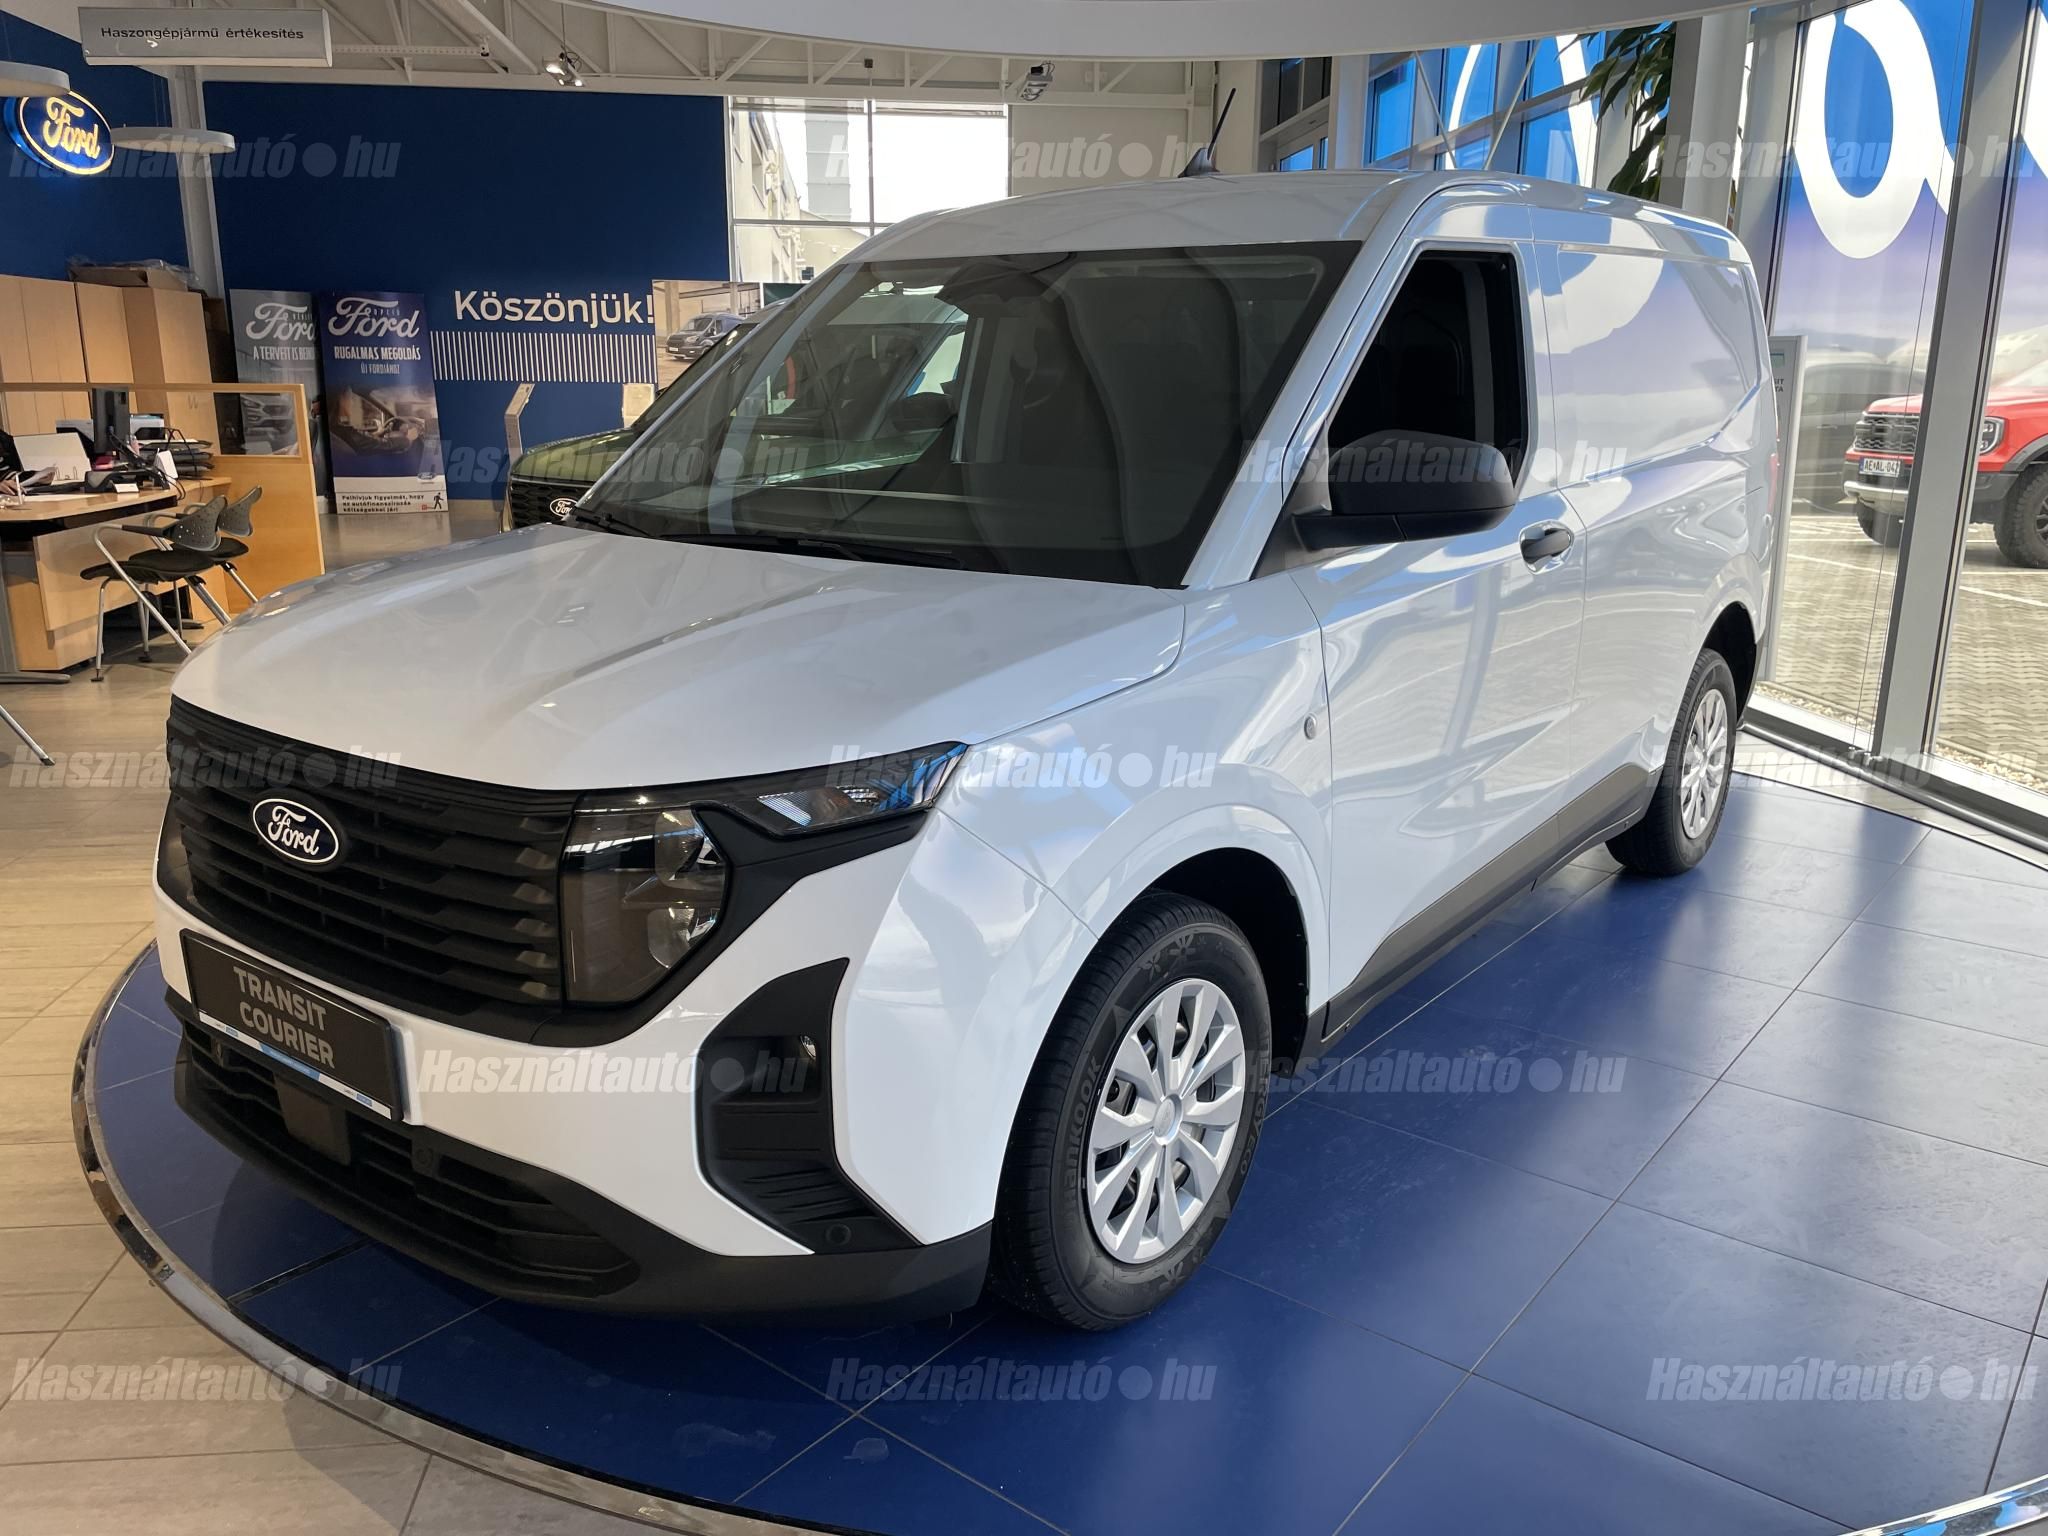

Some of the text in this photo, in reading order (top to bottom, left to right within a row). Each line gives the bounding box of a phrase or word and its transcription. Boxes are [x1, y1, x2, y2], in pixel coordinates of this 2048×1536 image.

[101, 27, 304, 40] Haszongépjármű értékesítés
[43, 96, 100, 159] Ford
[328, 297, 420, 338] Ford
[455, 290, 655, 328] Köszönjük!
[253, 346, 260, 360] A
[334, 345, 422, 360] RUGALMAS MEGOLDÁS
[555, 500, 573, 513] For
[267, 805, 320, 856] Ford
[233, 966, 327, 1031] TRANSIT
[239, 1002, 335, 1069] COURIER
